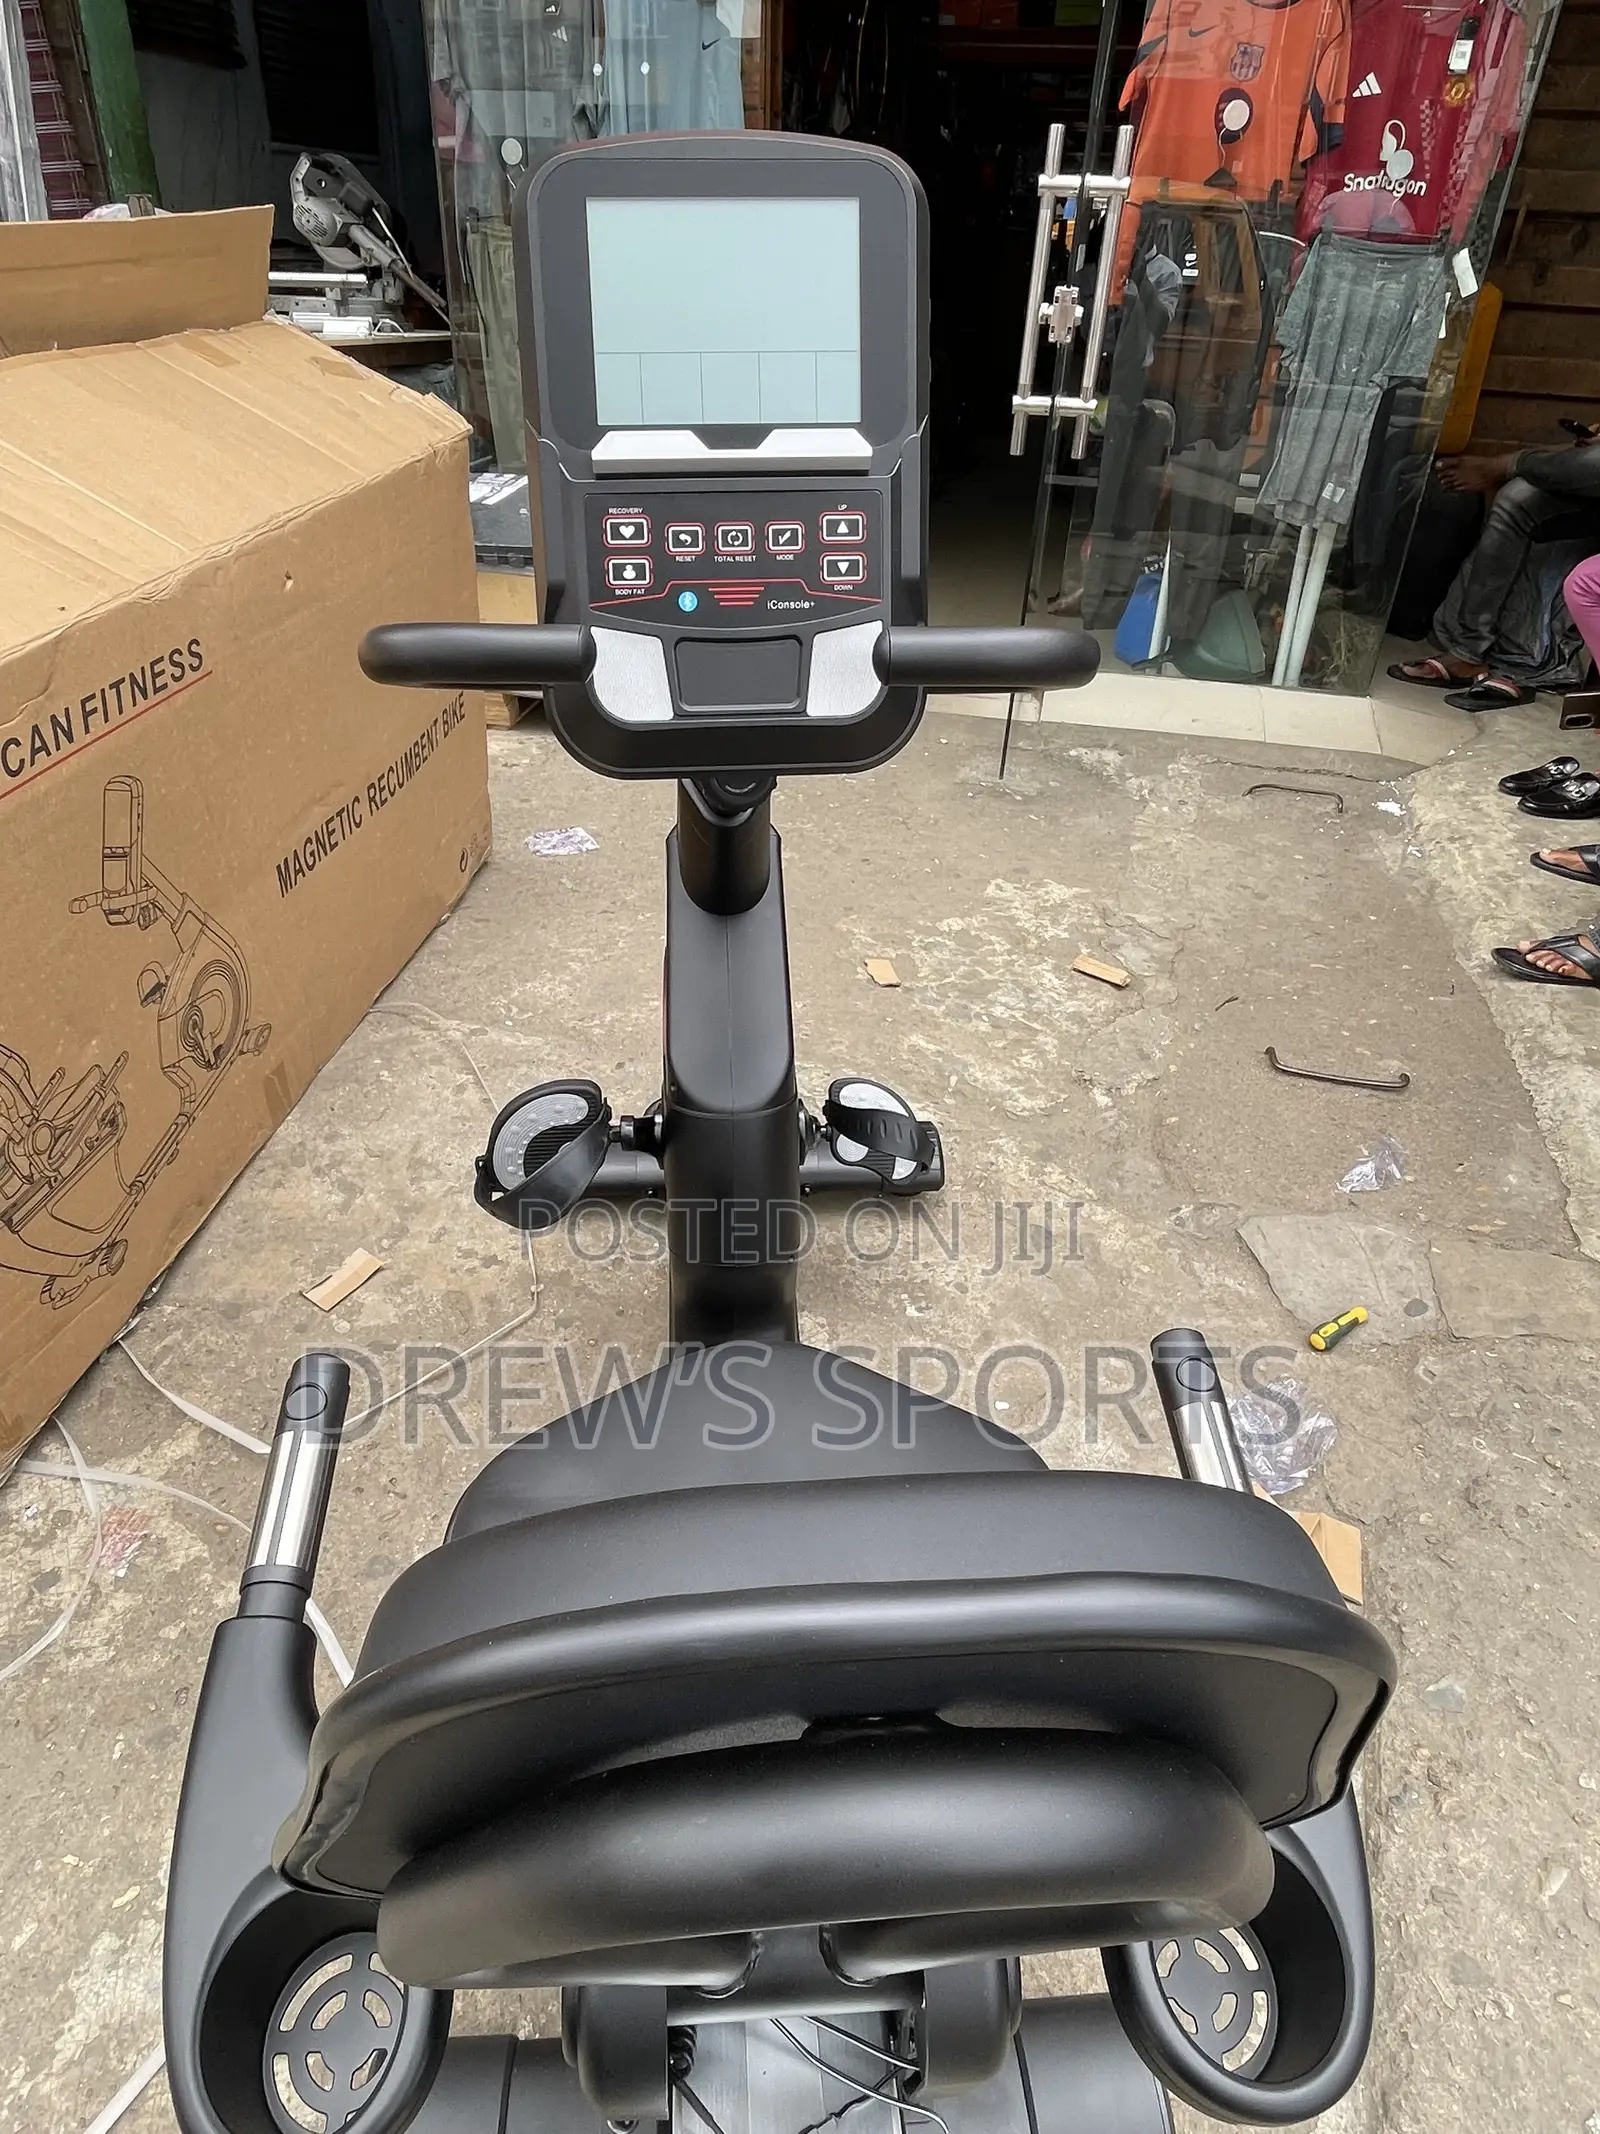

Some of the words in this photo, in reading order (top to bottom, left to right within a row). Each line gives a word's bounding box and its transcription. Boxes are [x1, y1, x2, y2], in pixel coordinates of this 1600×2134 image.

[1343, 169, 1427, 197] Snaragon
[767, 600, 815, 610] iConsole+
[80, 638, 203, 735] FITNESS
[276, 796, 363, 898] MAGNETIC
[366, 717, 439, 817] RECUMBENT
[441, 690, 466, 739] BIKE
